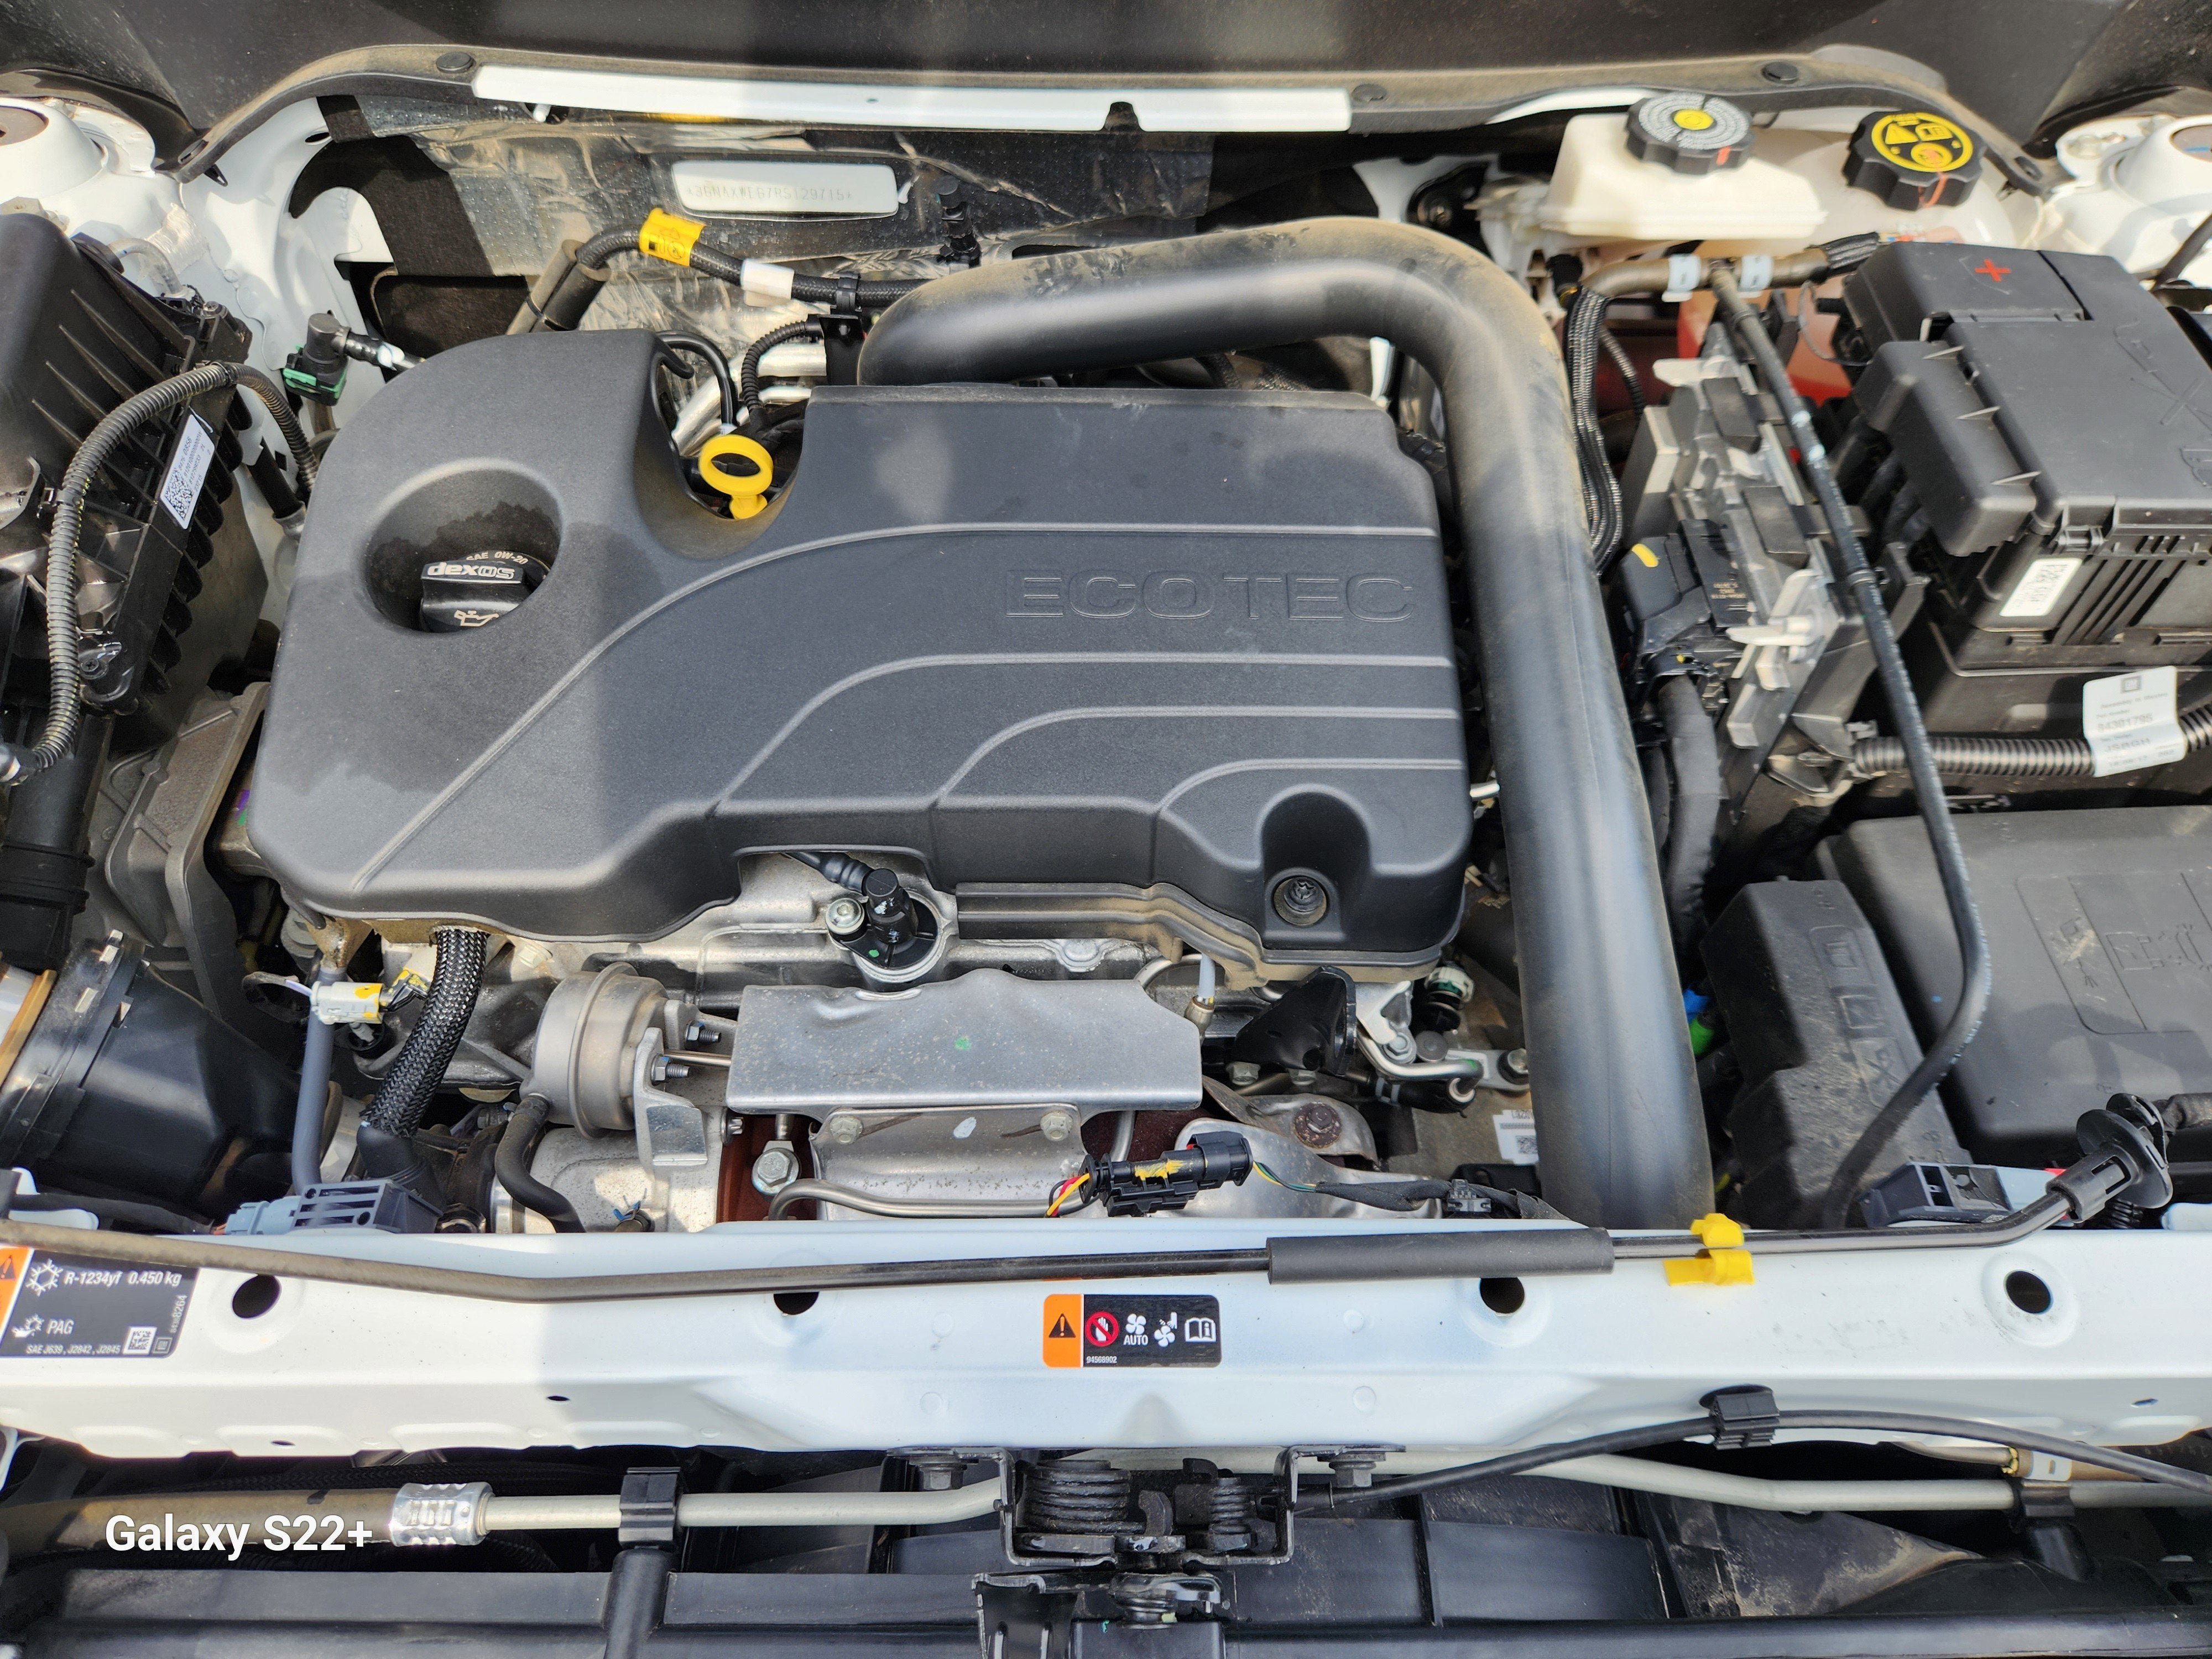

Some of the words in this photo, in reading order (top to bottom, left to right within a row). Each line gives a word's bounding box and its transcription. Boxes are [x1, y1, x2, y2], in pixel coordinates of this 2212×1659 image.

[466, 551, 489, 560] SAE
[494, 551, 528, 565] 0W-20
[427, 562, 515, 580] dexos
[1005, 569, 1415, 622] ECOTEC
[64, 1271, 123, 1287] R-1234yf
[128, 1271, 163, 1285] 0.450
[165, 1271, 182, 1287] kg
[46, 1319, 75, 1334] PAG
[1124, 1335, 1148, 1345] AUTO
[26, 1345, 43, 1354] SAE
[96, 1345, 121, 1354] J2845
